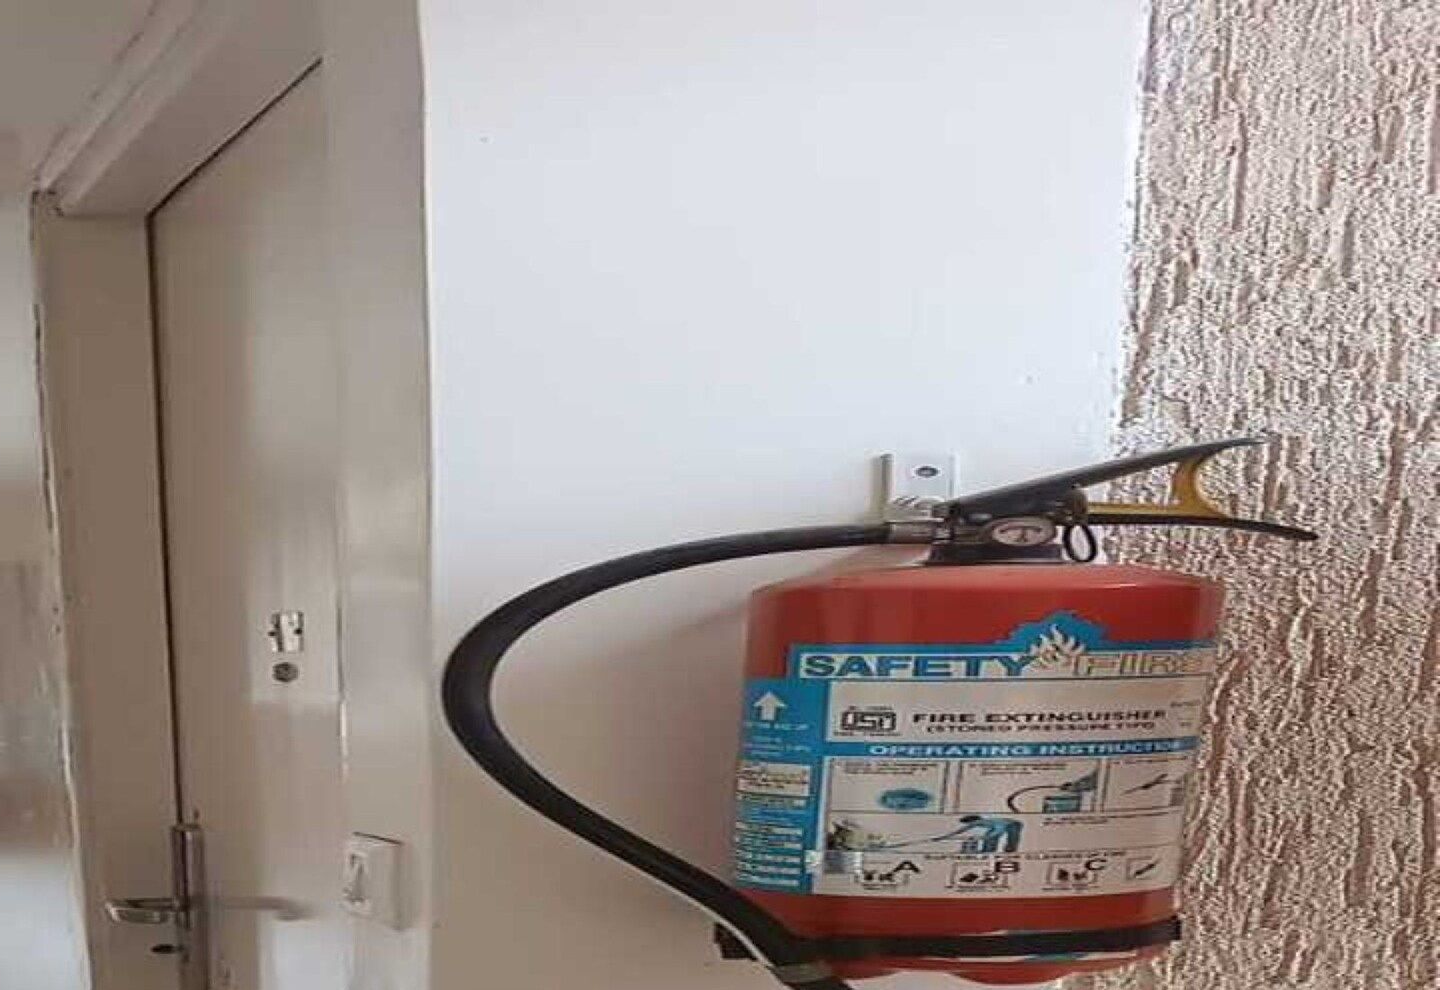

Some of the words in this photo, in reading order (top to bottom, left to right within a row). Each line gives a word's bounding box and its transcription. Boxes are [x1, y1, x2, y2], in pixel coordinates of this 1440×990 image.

[804, 655, 1032, 678] SAFETY
[913, 713, 976, 723] FIRE
[985, 710, 1166, 723] EXTINGUISHER
[870, 744, 1030, 756] OPERATING
[893, 860, 921, 874] A
